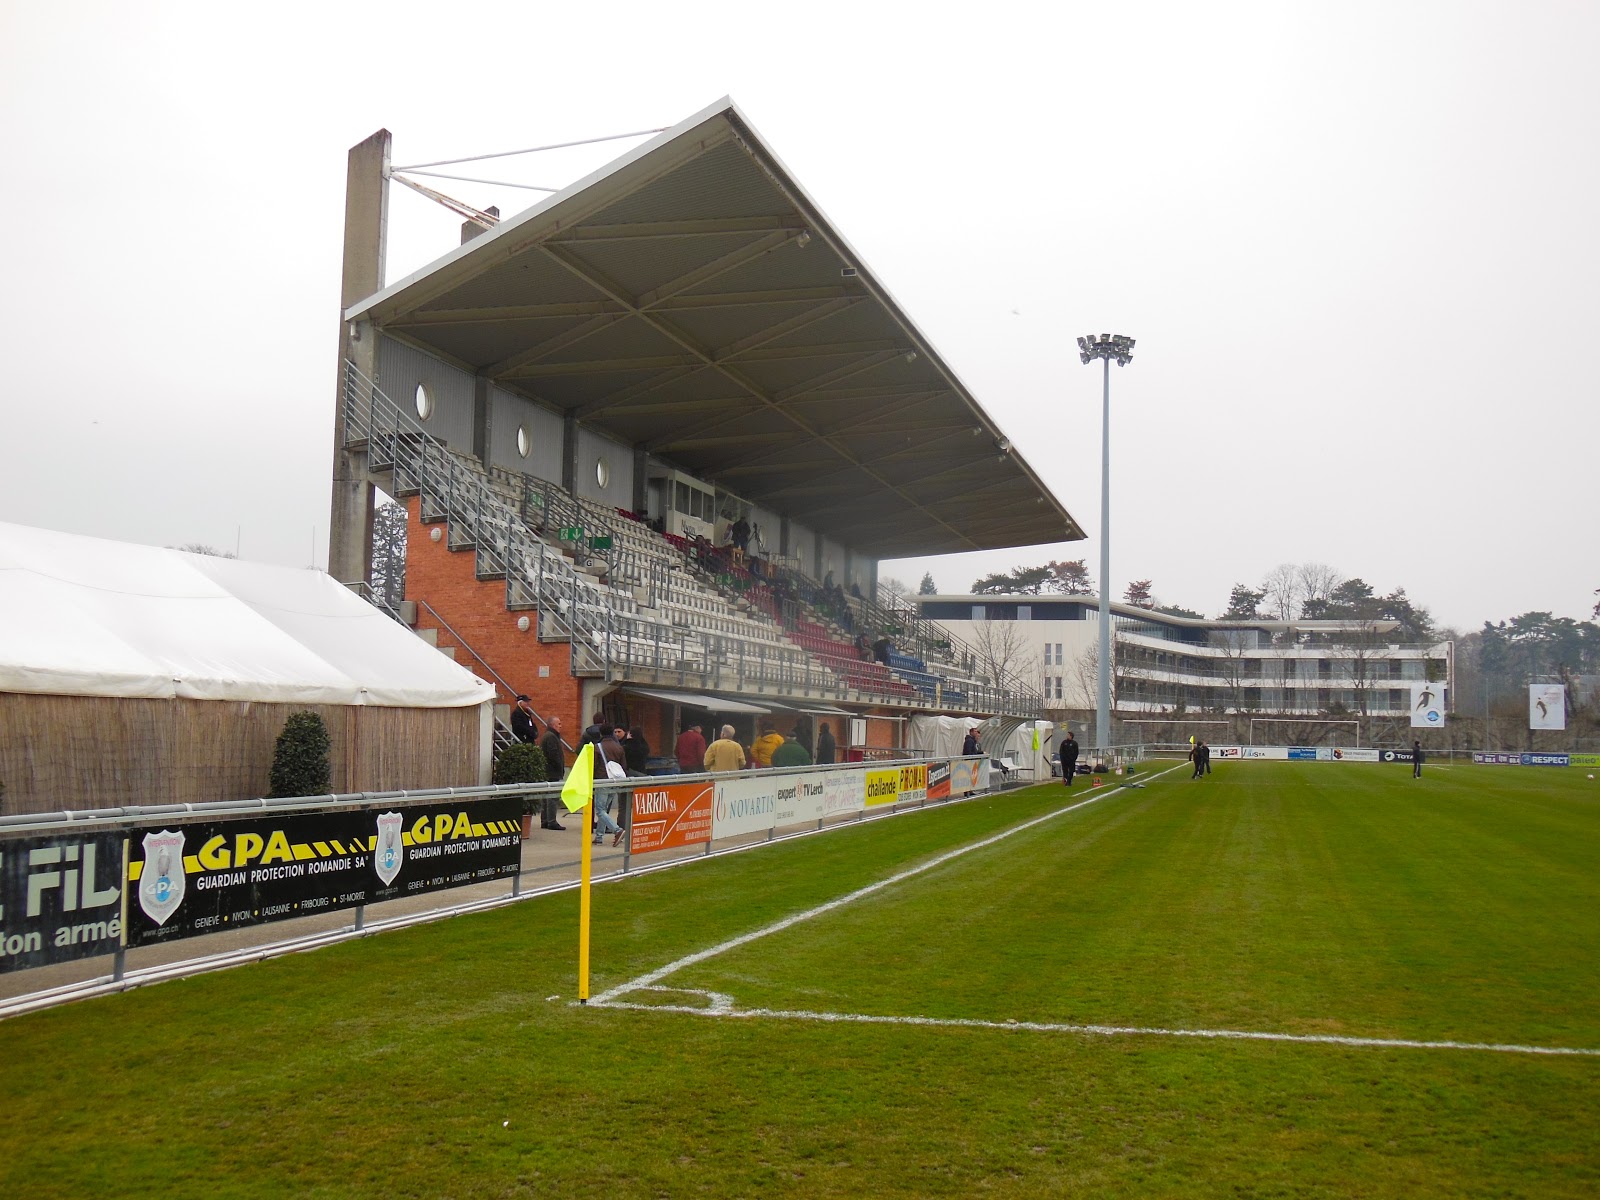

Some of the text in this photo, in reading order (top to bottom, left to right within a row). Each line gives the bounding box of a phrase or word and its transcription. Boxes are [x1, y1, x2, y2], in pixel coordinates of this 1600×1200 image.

[1532, 756, 1568, 764] RESPECT
[867, 776, 896, 798] challande
[899, 767, 926, 790] PROMA
[777, 781, 824, 801] expert TV Lerch
[634, 791, 669, 815] VARRIN
[669, 800, 677, 812] SA
[730, 795, 775, 819] NOVARTIS
[411, 812, 474, 844] GPA
[198, 830, 295, 870] GPA
[379, 851, 400, 863] GPA
[409, 846, 442, 860] GUARDIAN
[444, 841, 479, 855] PROTECTION
[482, 837, 511, 850] ROMANDIE
[196, 872, 246, 891] GUARDIAN
[250, 864, 304, 883] PROTECTION
[308, 858, 352, 875] ROMANDIE
[432, 876, 444, 886] NYON
[451, 872, 471, 883] LAUSANNE
[477, 868, 496, 877] FRIBOURG
[145, 881, 180, 895] GPA
[232, 910, 250, 922] NYON
[261, 903, 291, 917] LAUSANNE
[301, 896, 330, 910] FRIBOURG
[339, 891, 366, 904] ST-MORITZ
[54, 913, 121, 947] armé
[142, 924, 180, 937] www.gpa.ch
